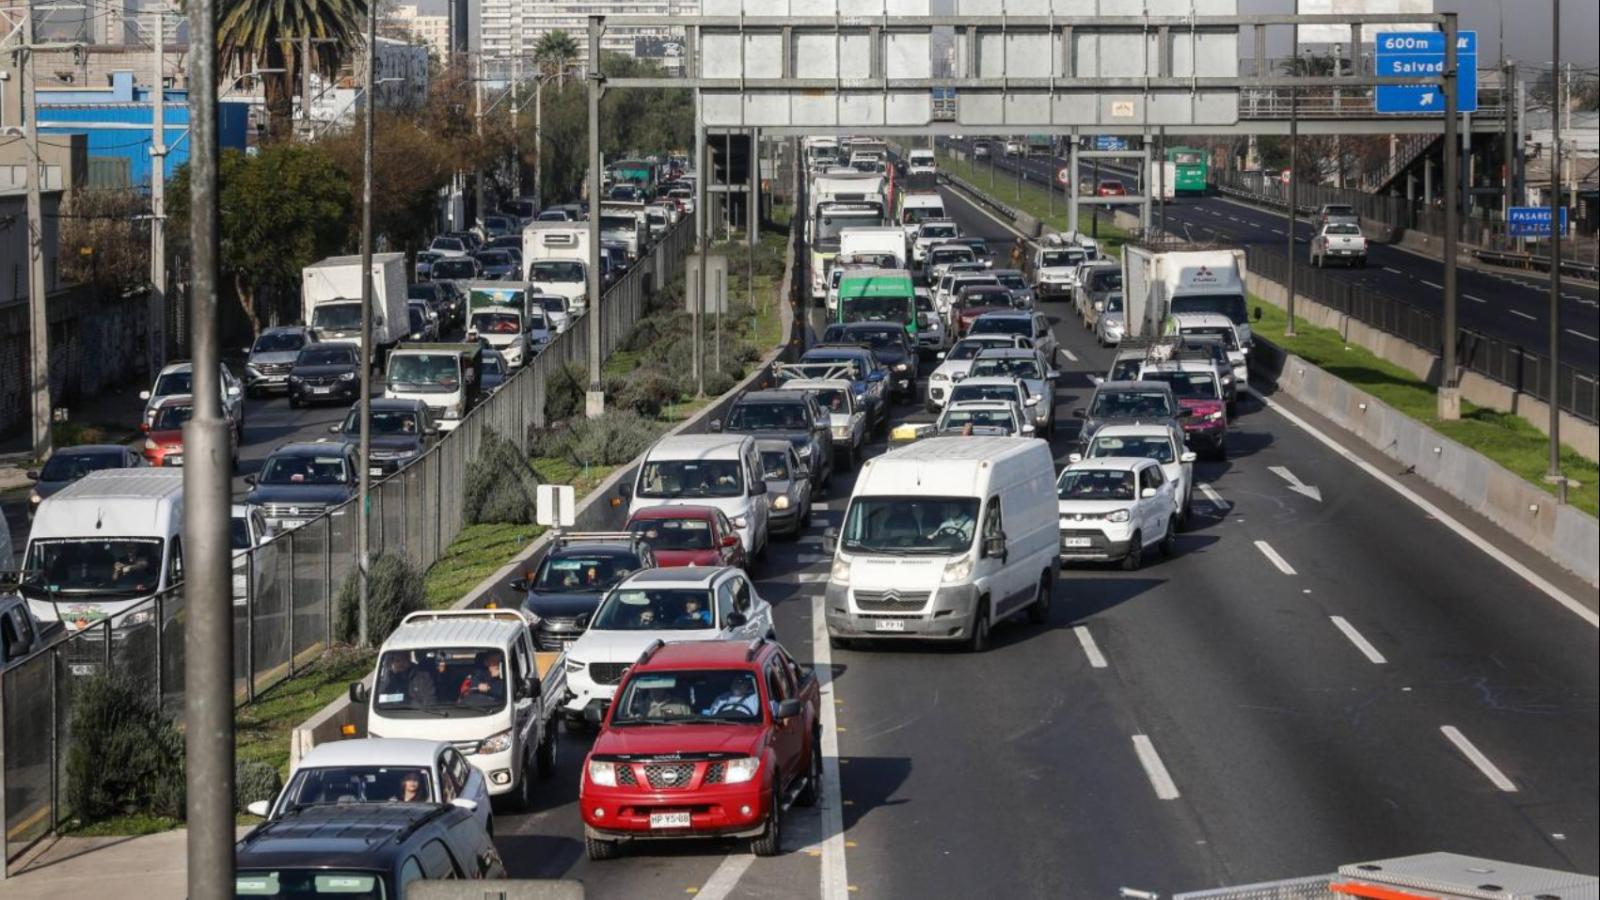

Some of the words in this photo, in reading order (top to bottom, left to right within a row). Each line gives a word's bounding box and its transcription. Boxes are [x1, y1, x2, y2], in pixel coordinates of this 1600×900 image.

[1385, 38, 1429, 49] 600m
[1393, 61, 1460, 72] Salvad
[1512, 212, 1556, 220] PASARE
